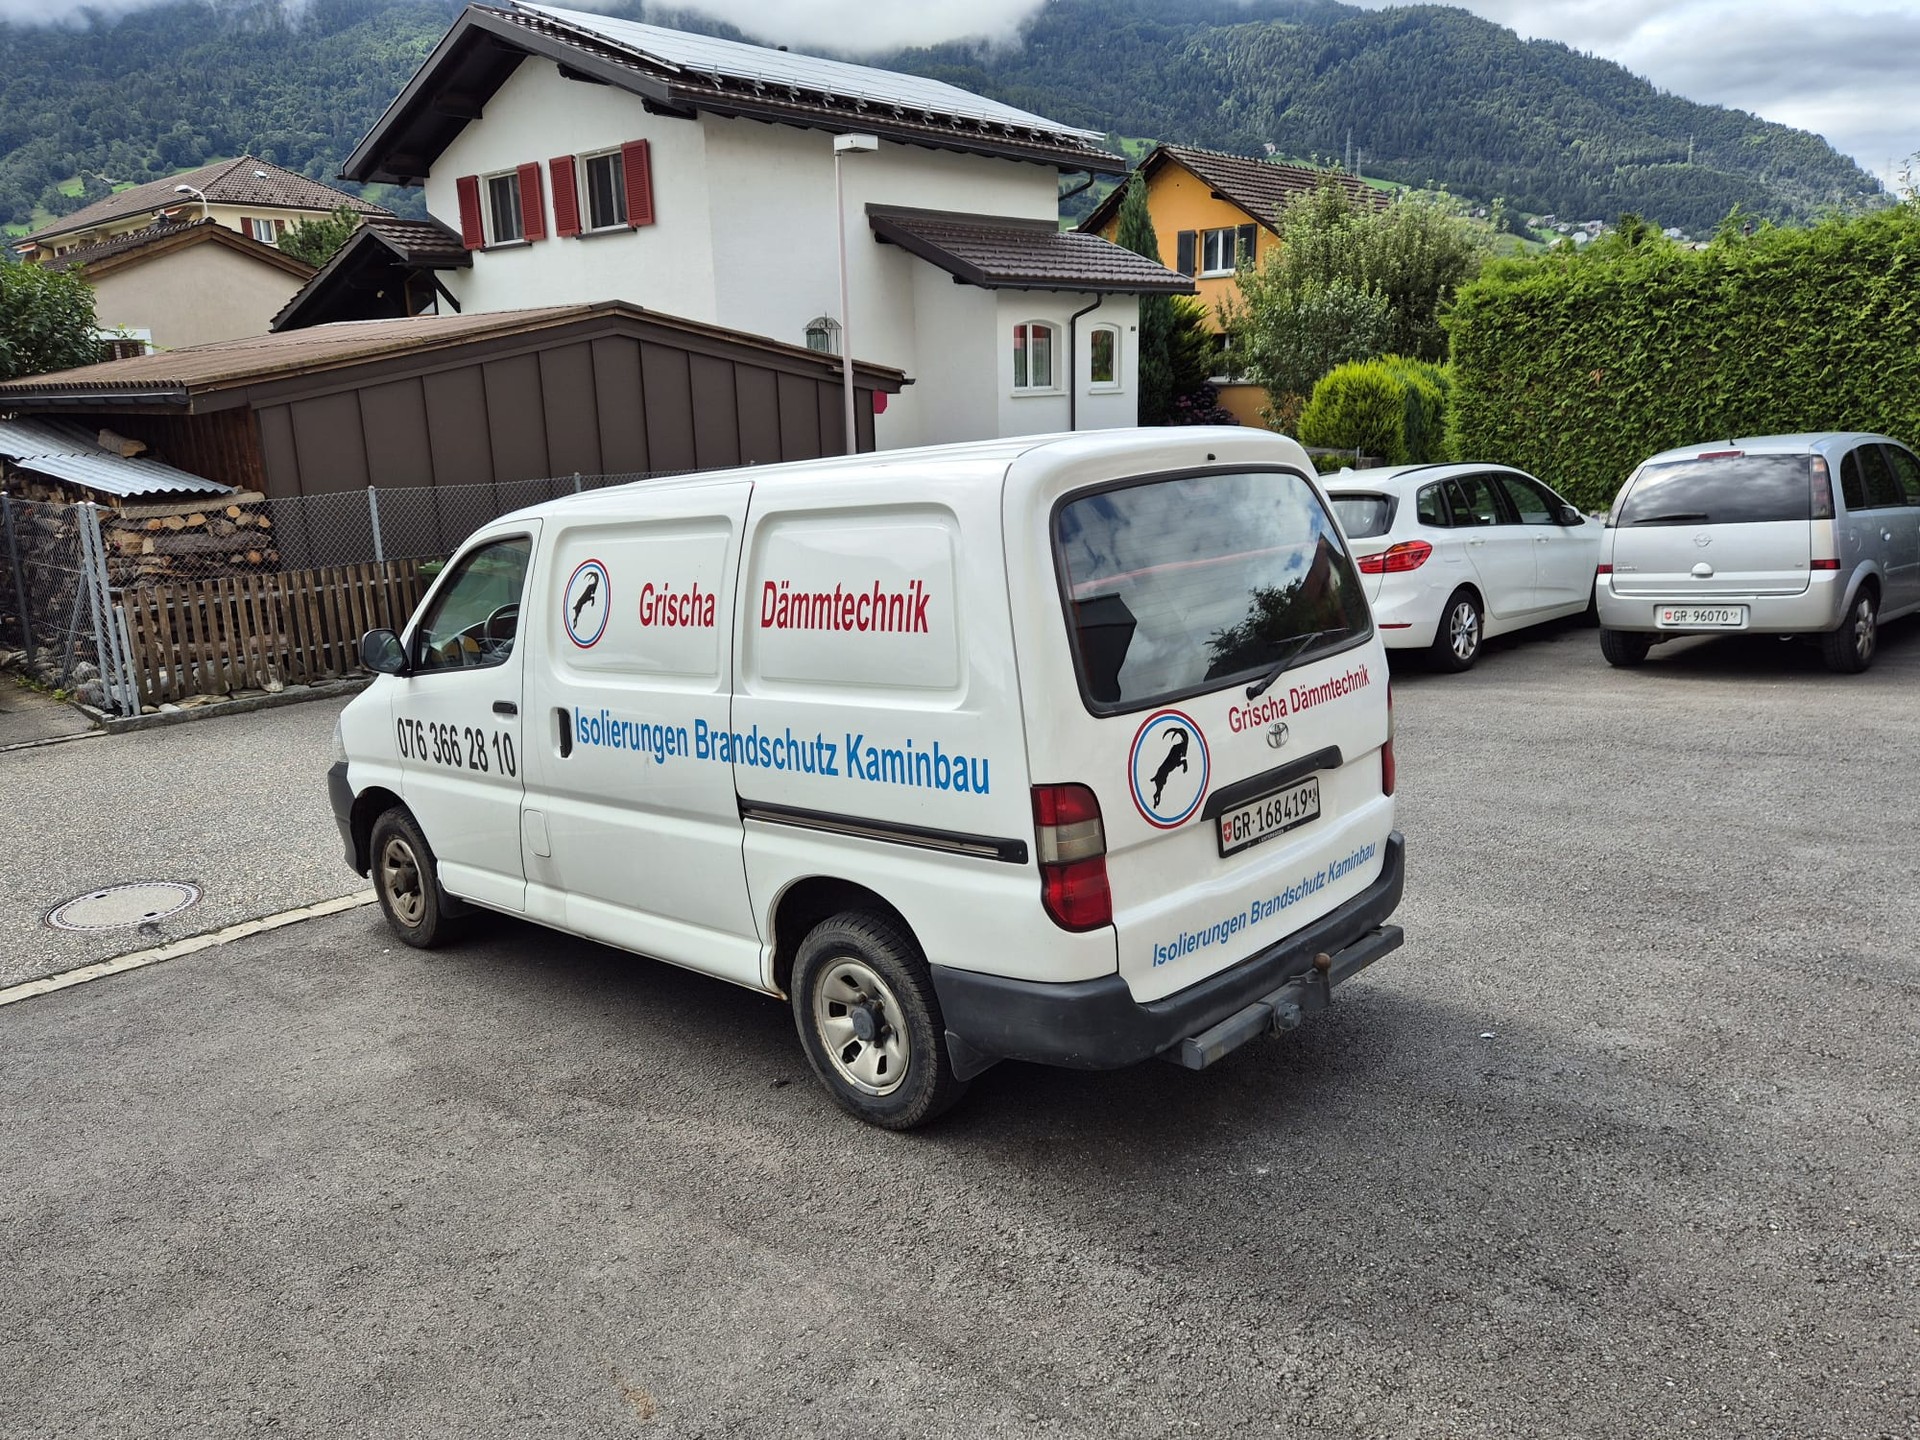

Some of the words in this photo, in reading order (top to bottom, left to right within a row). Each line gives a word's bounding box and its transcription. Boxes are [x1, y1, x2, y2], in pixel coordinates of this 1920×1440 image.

[638, 581, 716, 628] Grischa
[760, 579, 931, 634] Dämmtechnik
[1228, 697, 1288, 733] Grischa
[1289, 664, 1371, 713] Dämmtechnik
[397, 717, 428, 761] 076
[429, 721, 463, 768] 366
[464, 726, 489, 773] 28
[492, 731, 517, 778] 10
[574, 707, 689, 765] Isolierungen
[694, 718, 839, 777] Brandschutz
[845, 733, 990, 795] Kaminbau
[1152, 909, 1248, 968] Isolierungen
[1250, 870, 1327, 926] Brandschutz
[1327, 841, 1377, 885] Kaminbau
